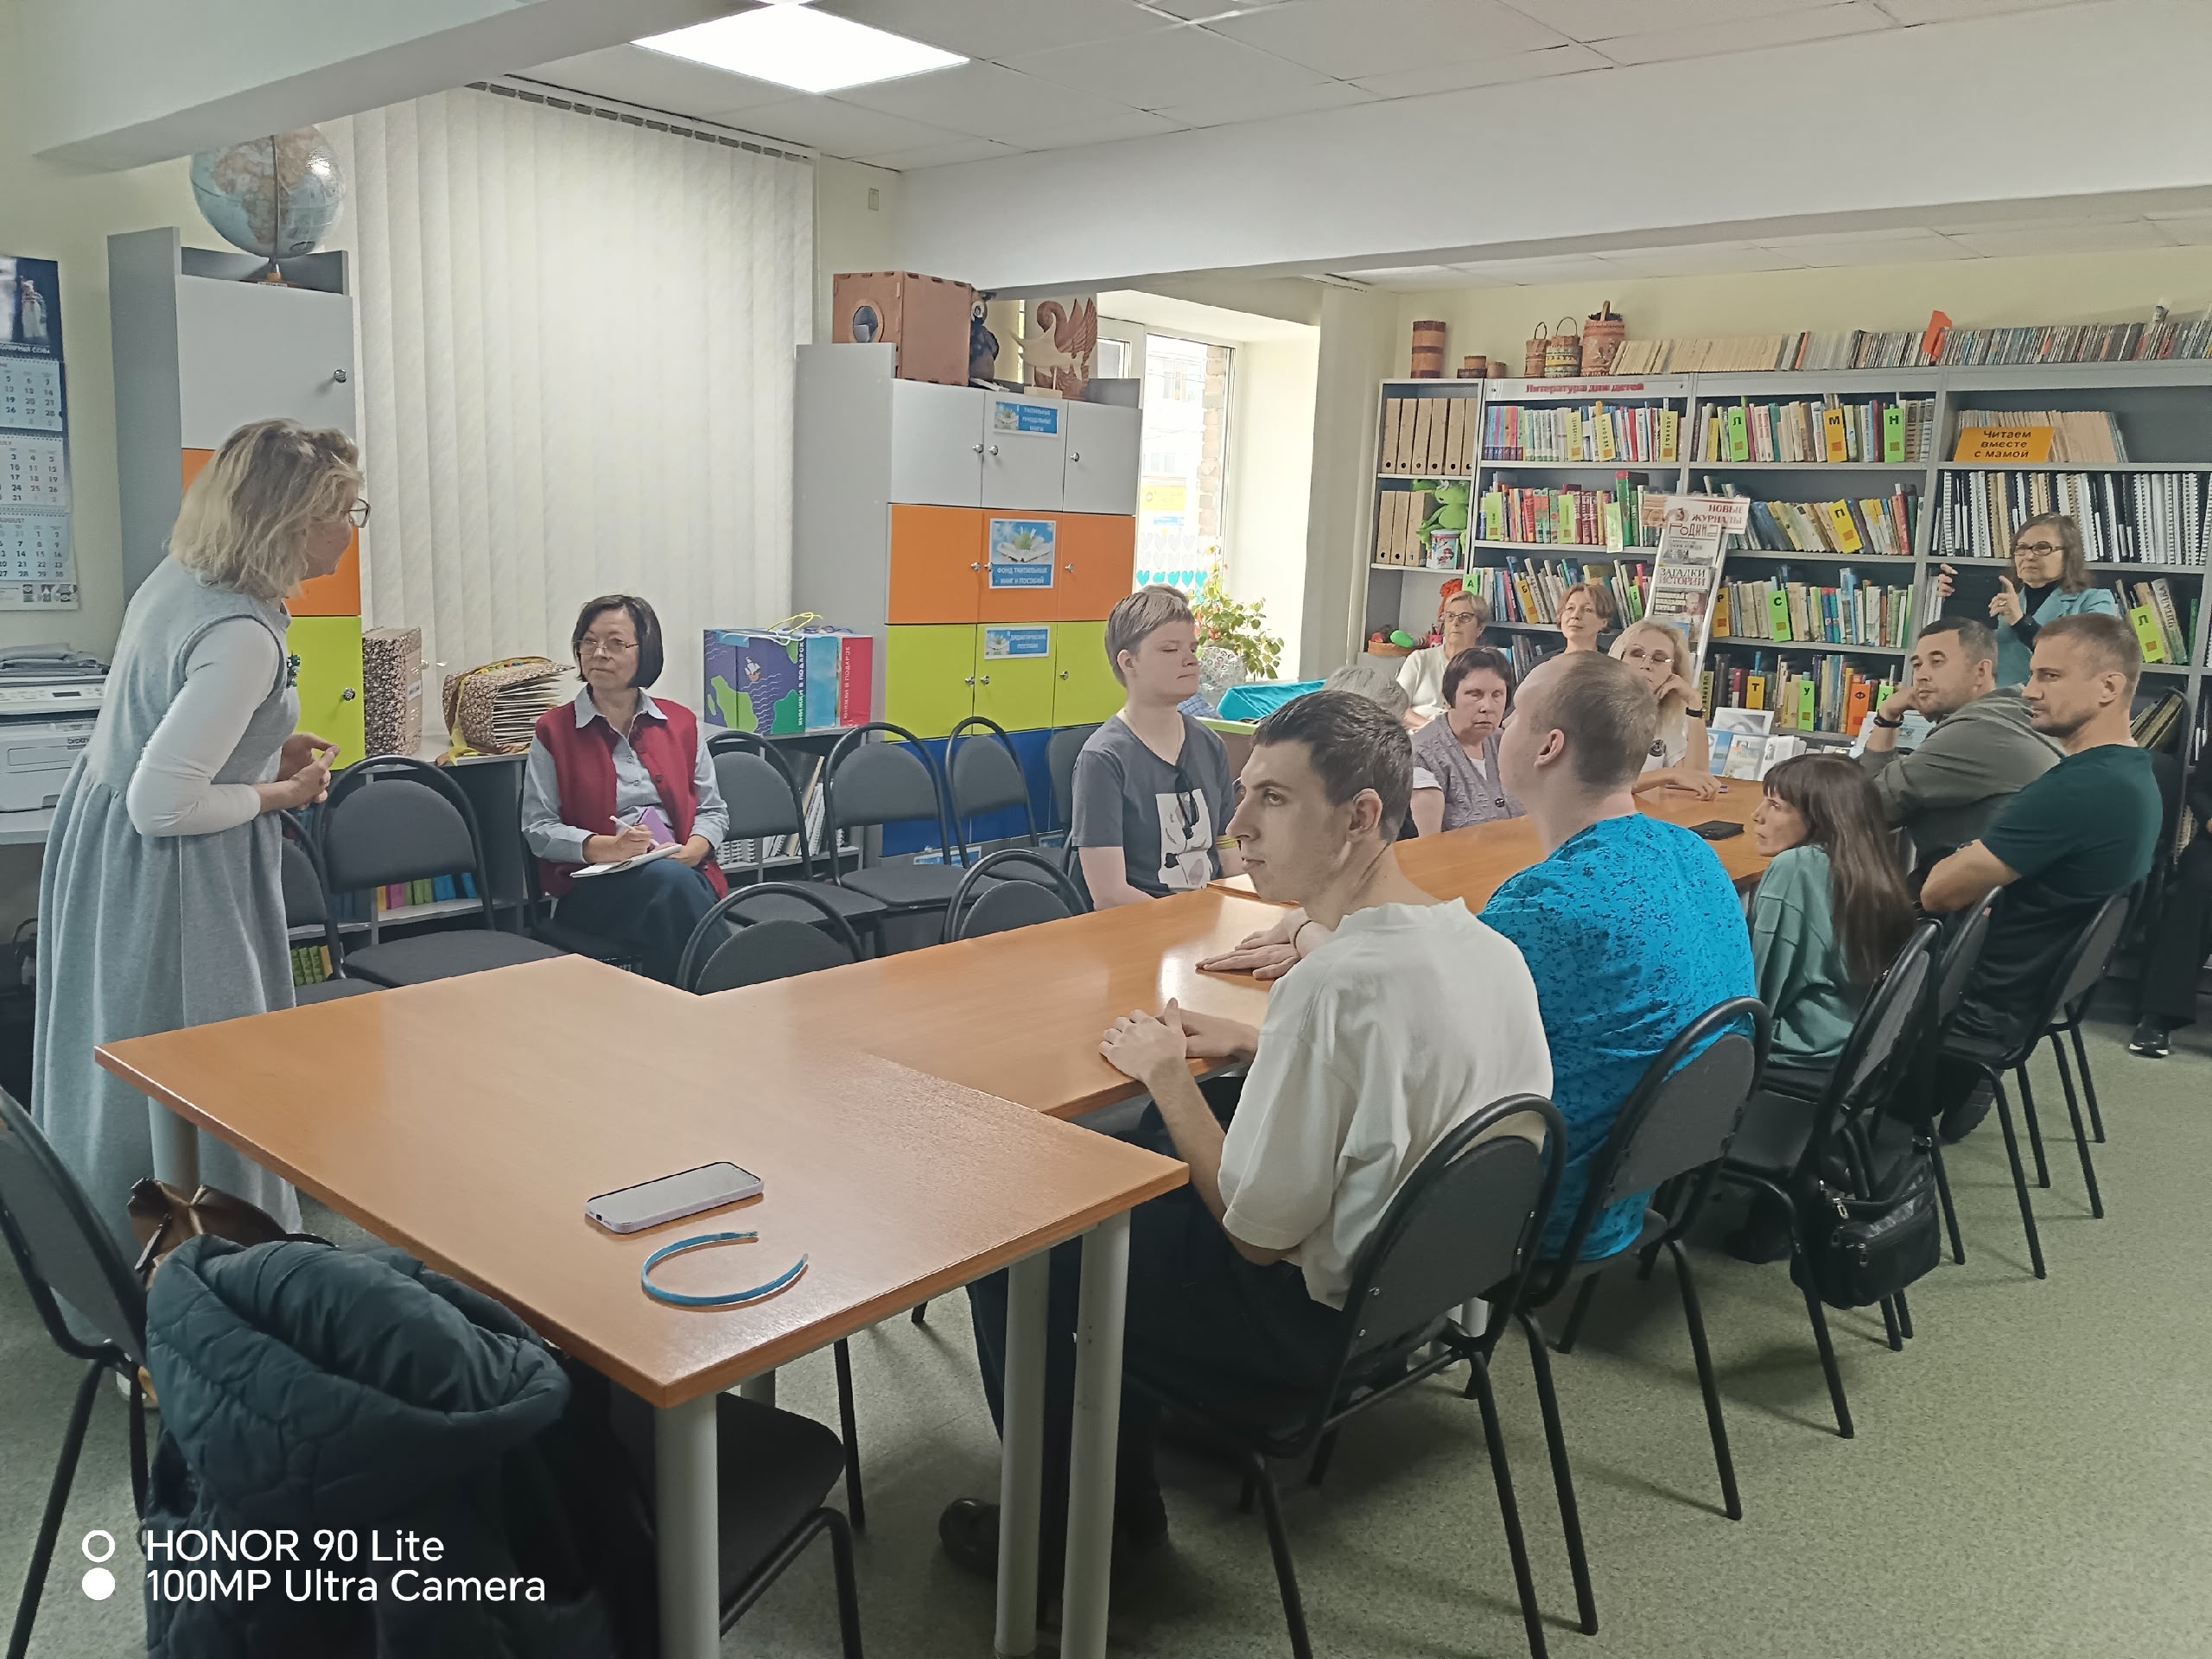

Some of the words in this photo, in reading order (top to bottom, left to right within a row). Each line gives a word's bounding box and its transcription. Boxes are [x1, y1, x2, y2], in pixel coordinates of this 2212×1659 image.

[1828, 416, 1840, 425] М
[1889, 416, 1899, 424] Н
[1709, 505, 1742, 513] НОВЫЕ
[1692, 514, 1741, 524] ЖУРНАЛЫ
[1661, 569, 1706, 577] ЗАГАДКИ
[1659, 576, 1706, 586] ИСТОРИИ
[1774, 597, 1783, 607] С
